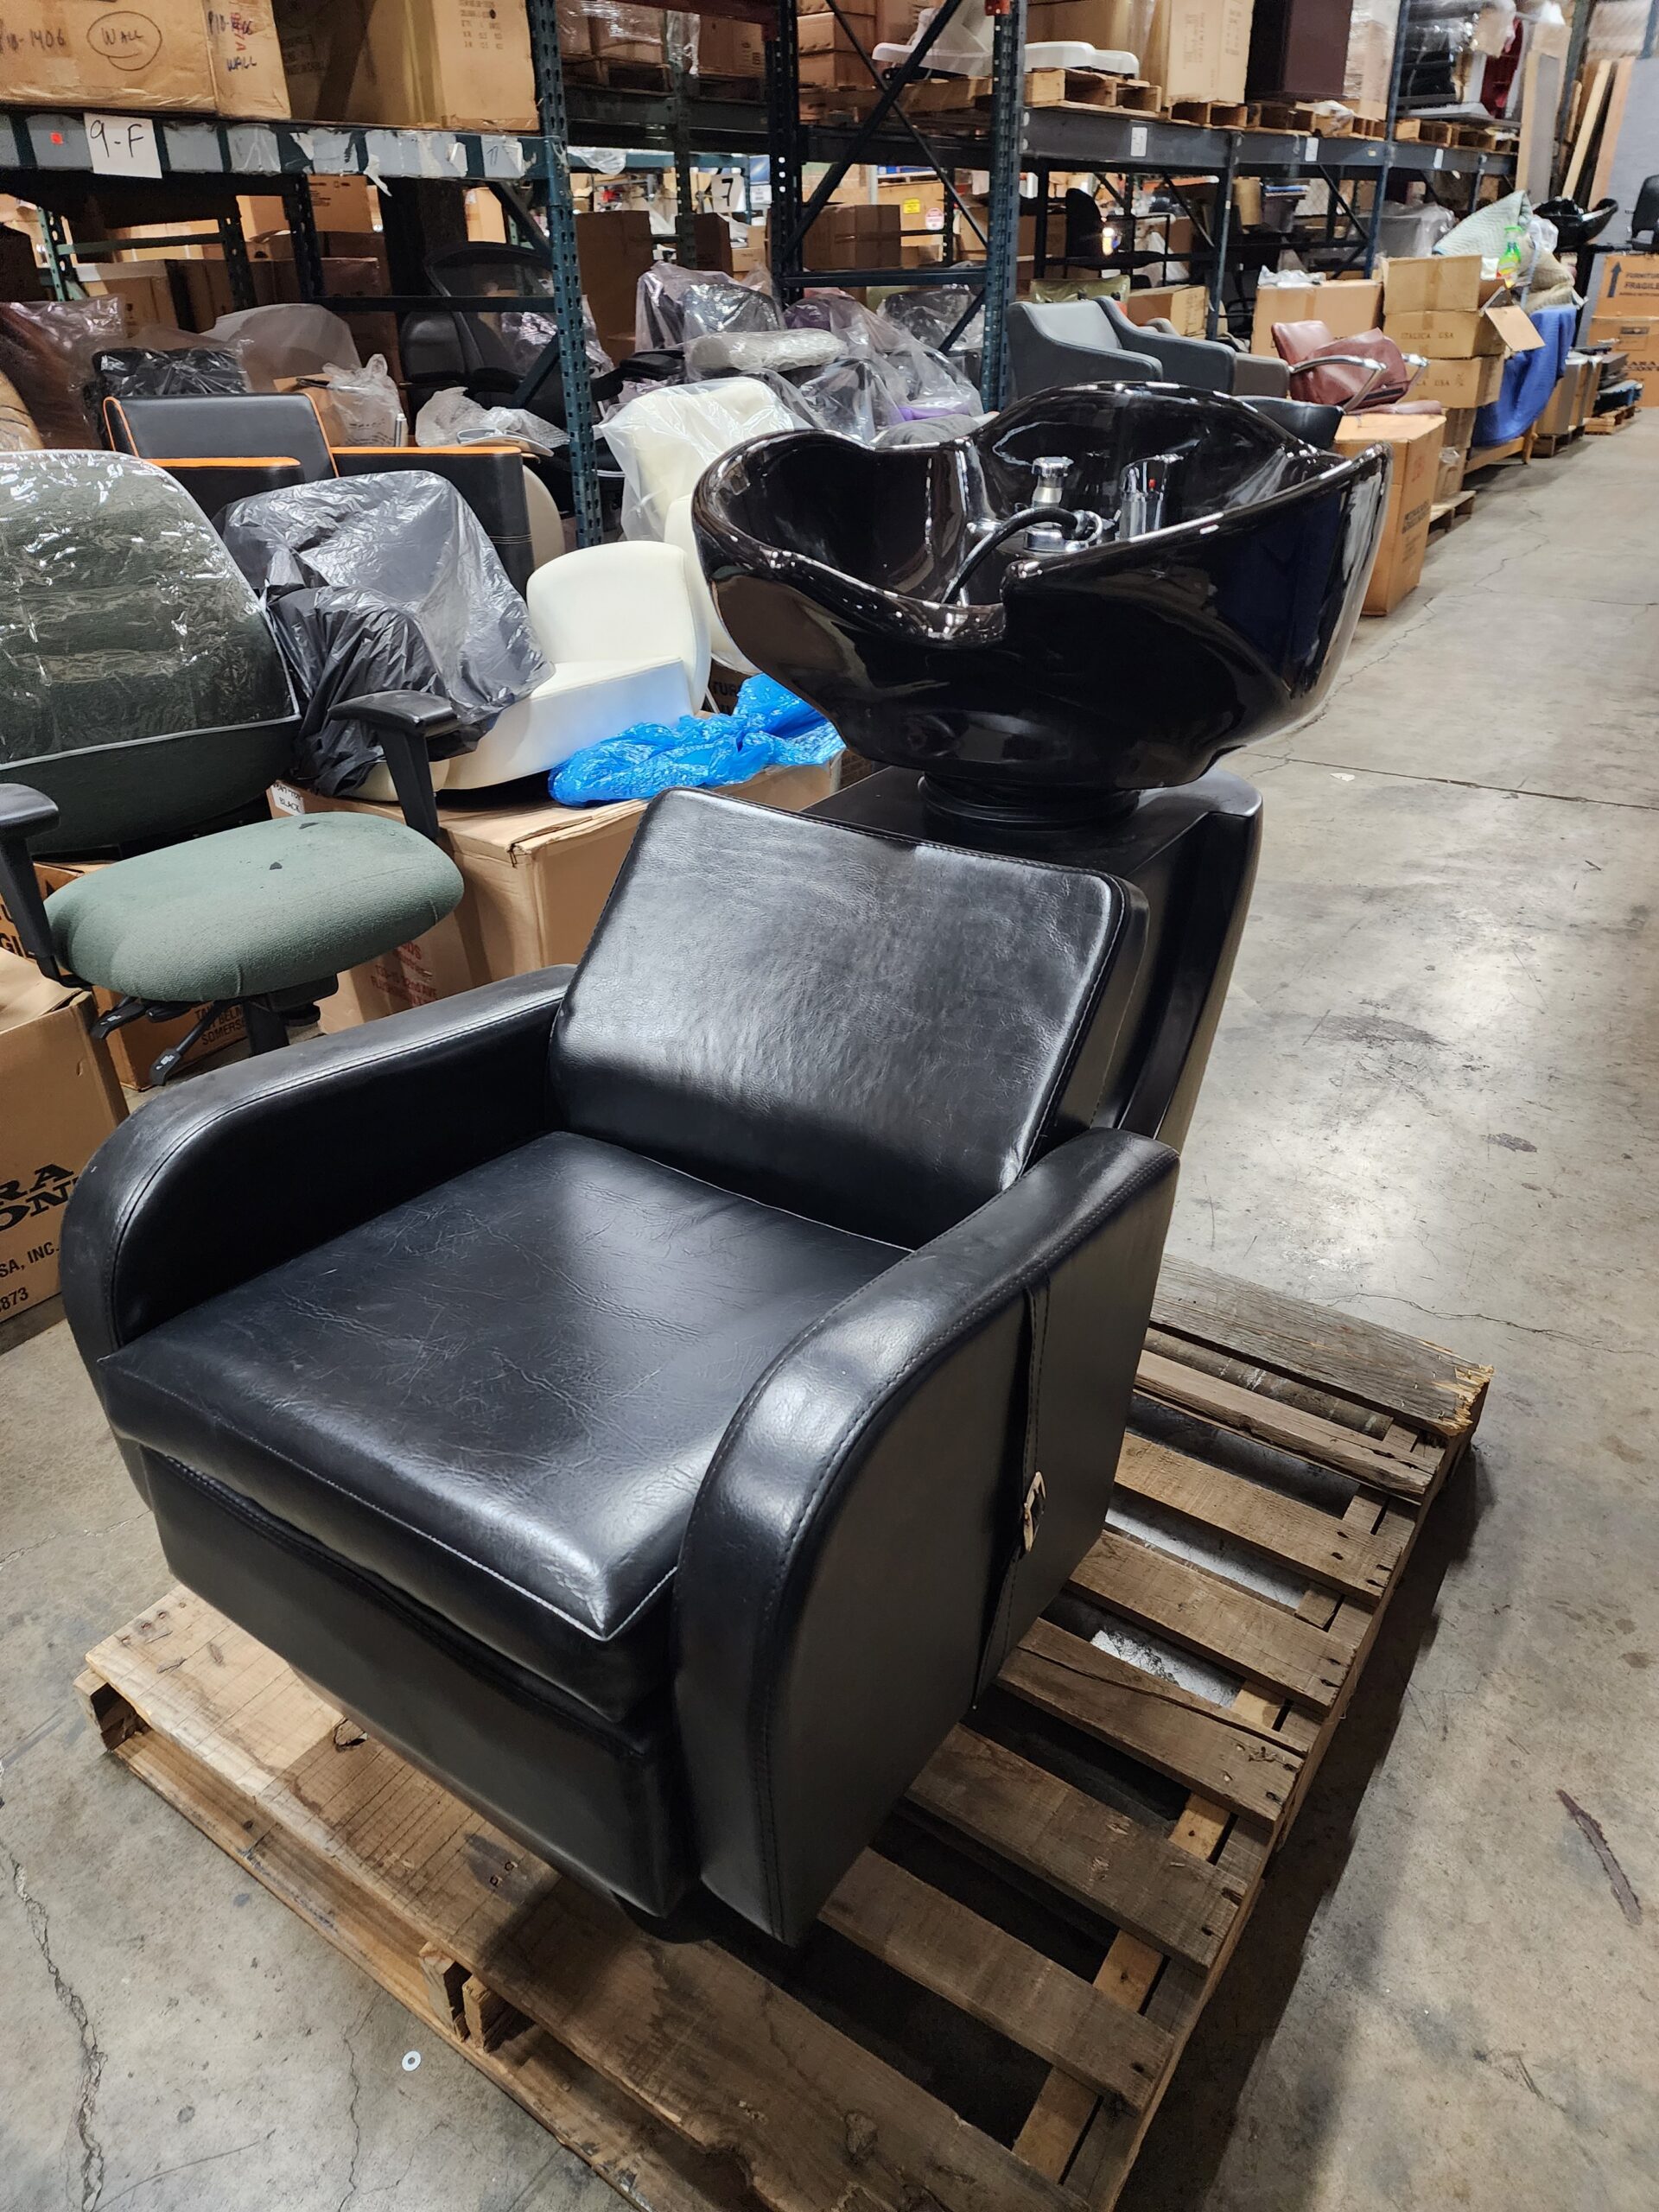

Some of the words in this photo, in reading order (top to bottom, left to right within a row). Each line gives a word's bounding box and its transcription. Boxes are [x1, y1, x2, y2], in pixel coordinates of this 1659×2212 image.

[101, 27, 143, 46] WALL
[226, 55, 257, 73] WALL
[90, 118, 144, 158] 9-F
[721, 177, 734, 207] 7
[28, 1241, 60, 1264] INC.
